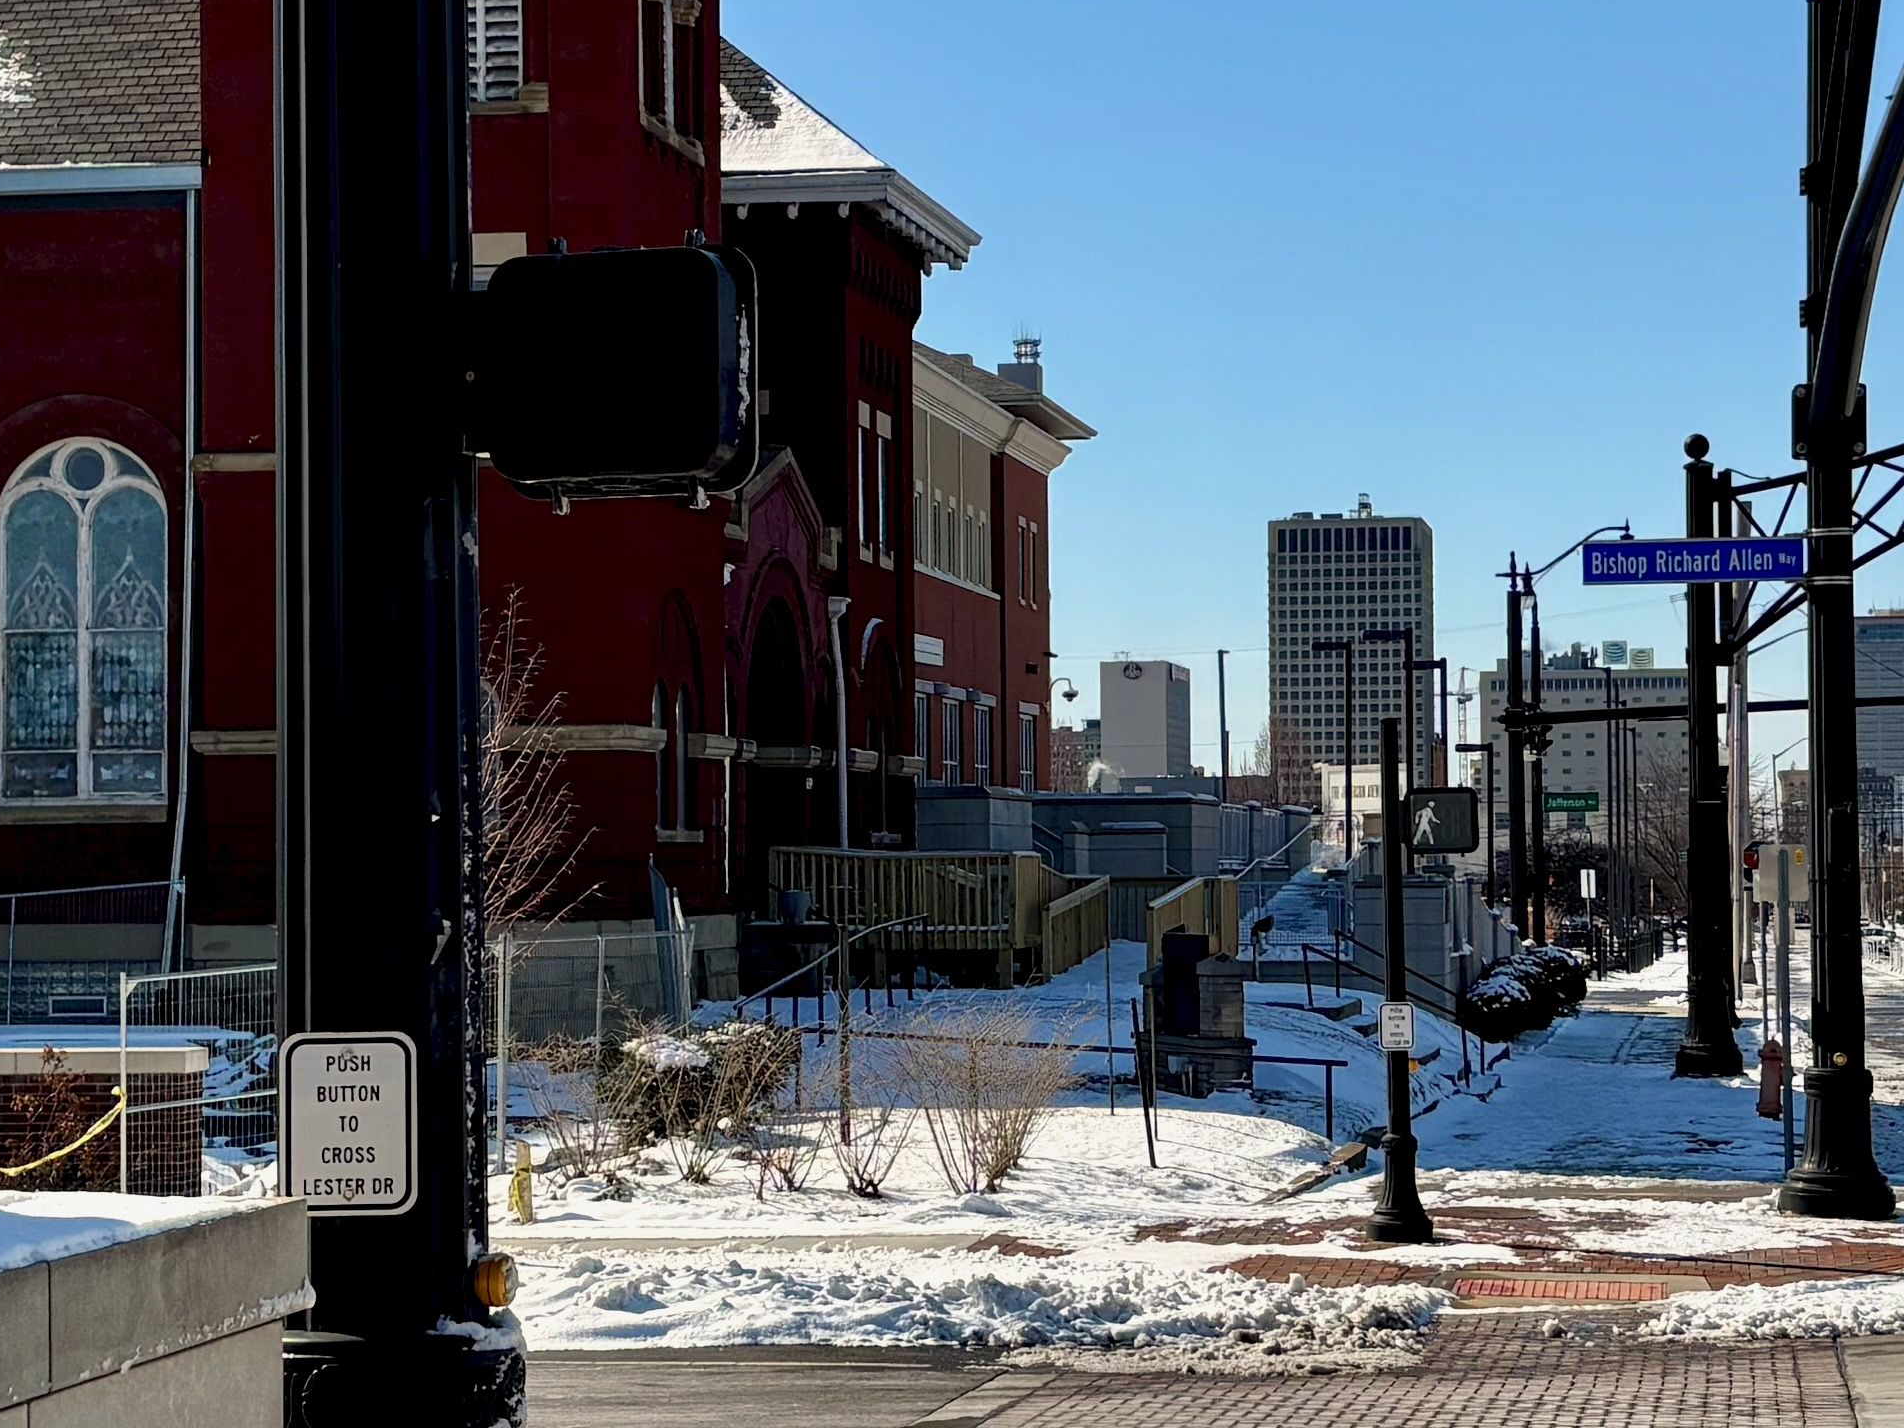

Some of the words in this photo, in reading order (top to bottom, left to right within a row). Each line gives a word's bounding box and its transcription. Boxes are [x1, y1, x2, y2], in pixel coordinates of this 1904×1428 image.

[1591, 552, 1647, 579] Bishop
[1656, 549, 1720, 572] Richard
[1728, 548, 1773, 571] Allen
[326, 1055, 371, 1072] PUSH
[317, 1085, 380, 1102] BUTTON
[339, 1115, 359, 1133] TO
[321, 1147, 376, 1164] CROSS
[303, 1178, 365, 1196] LESTER
[372, 1177, 394, 1194] DR
